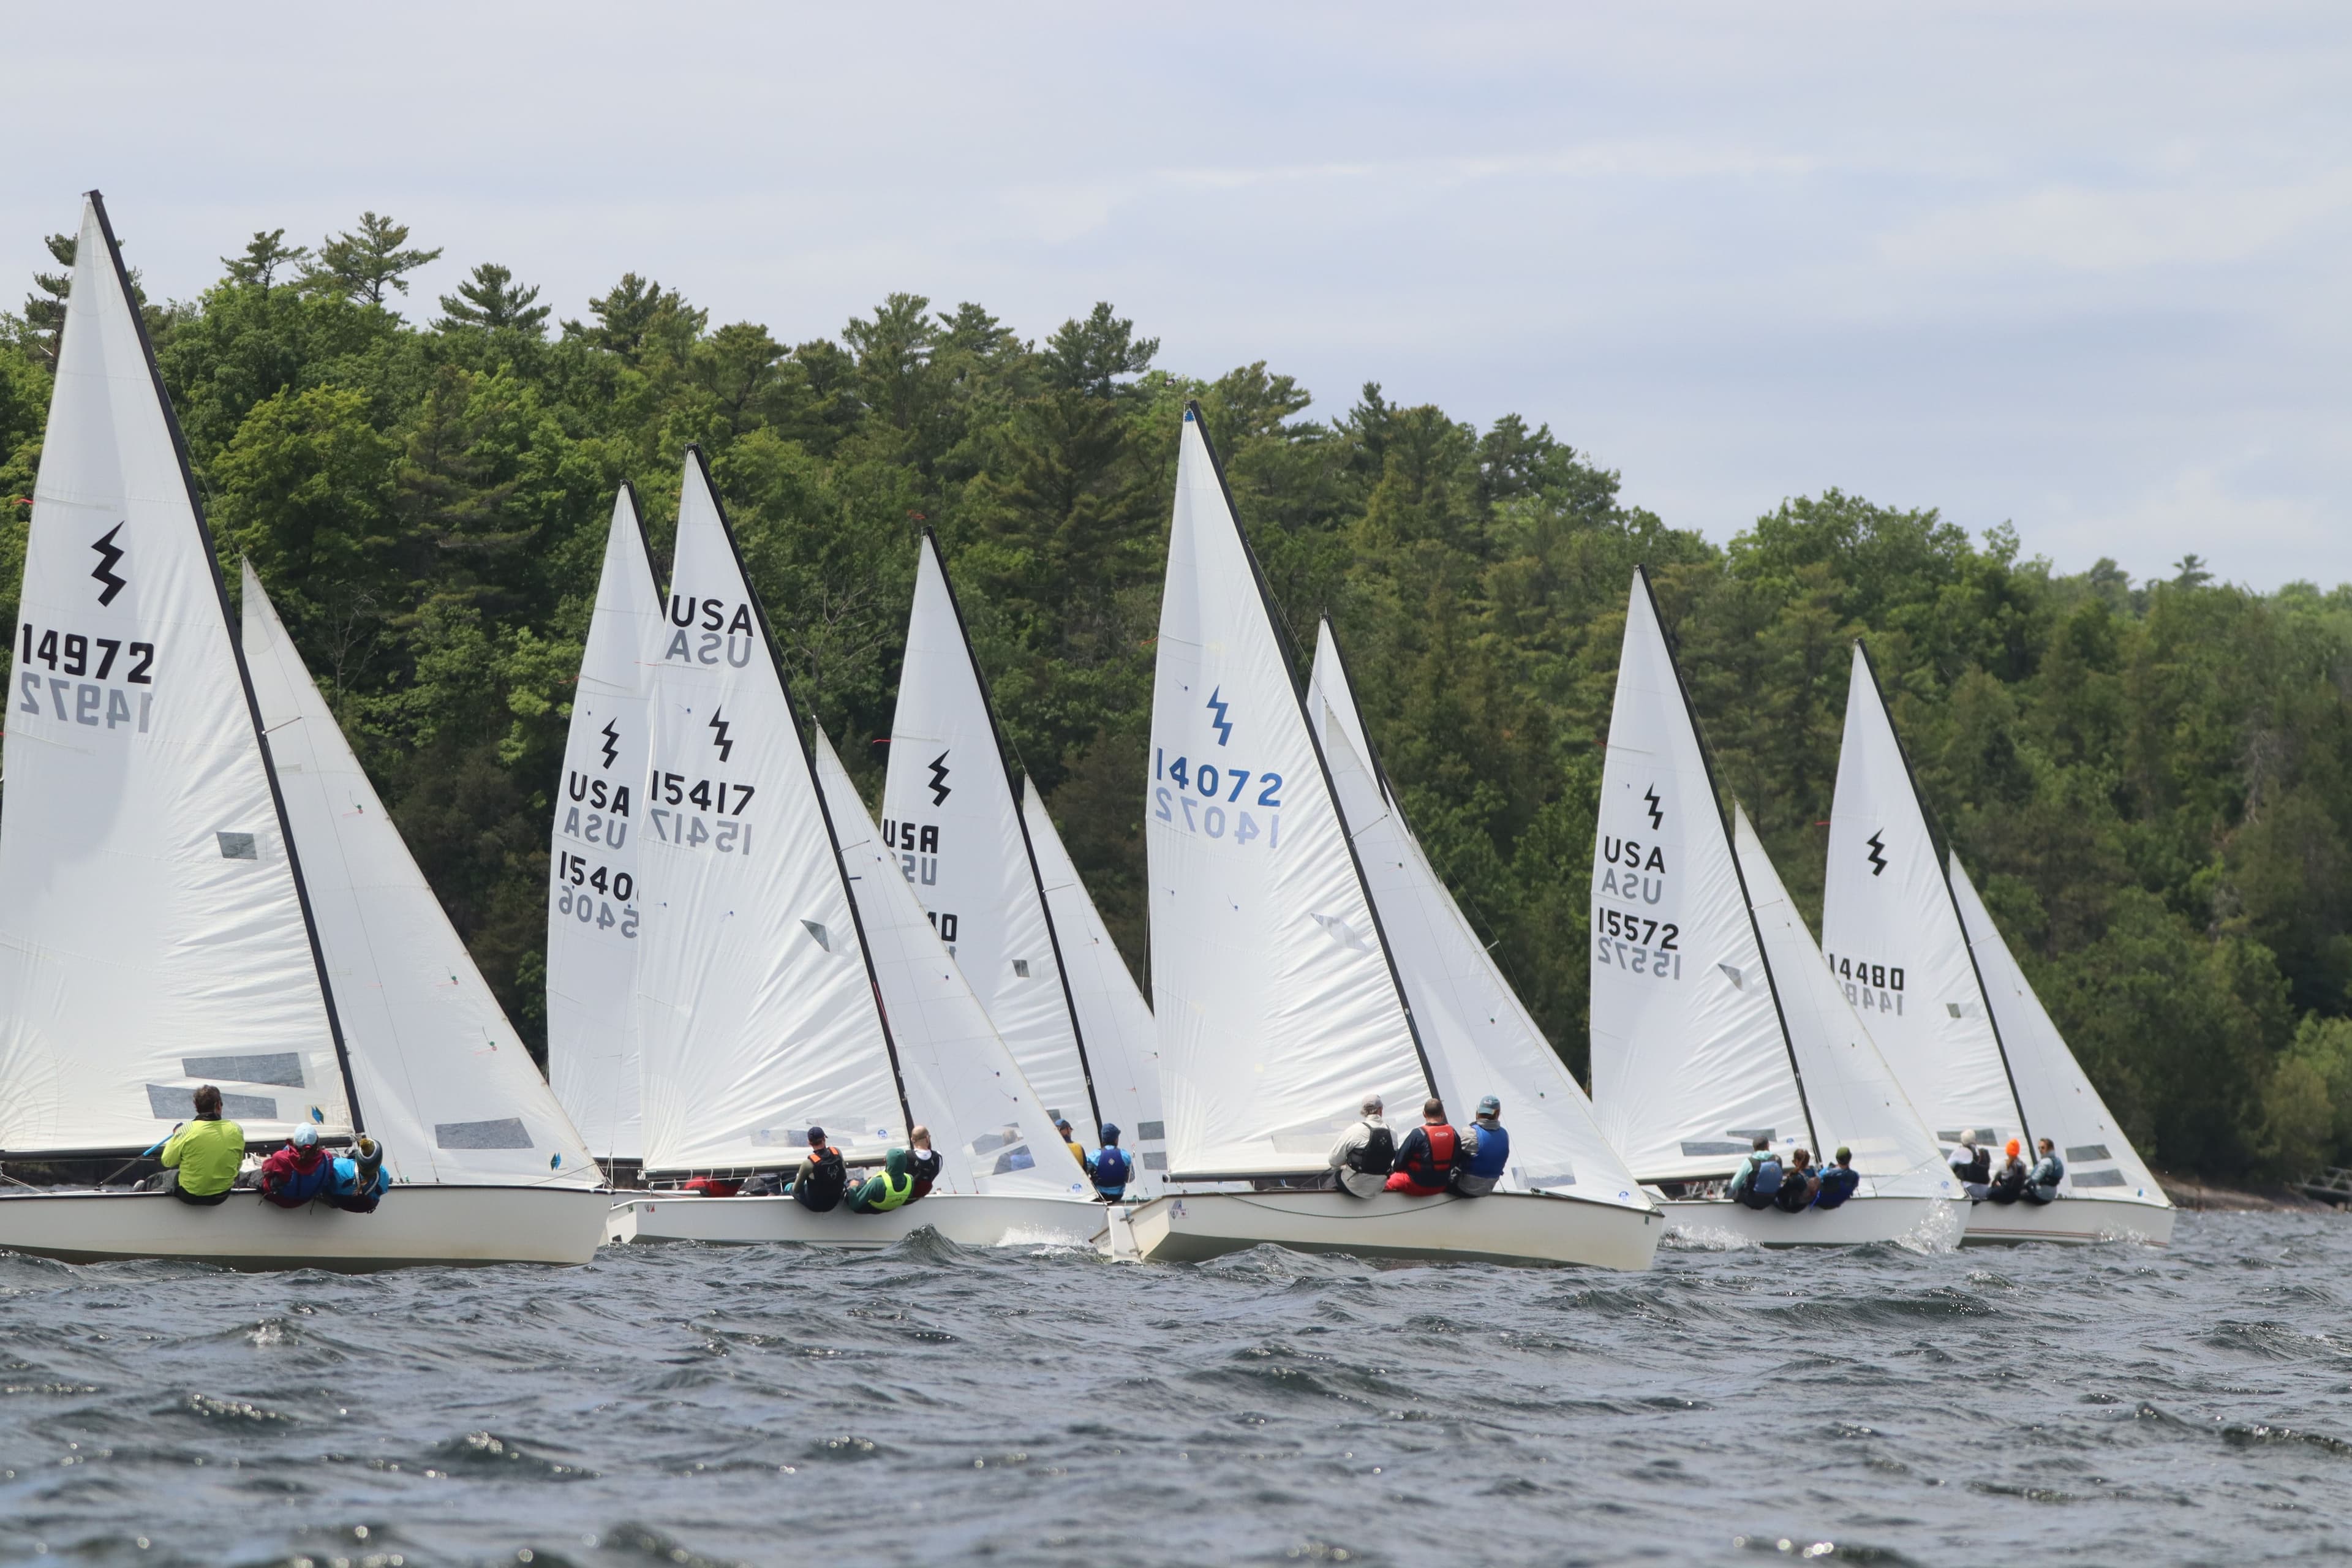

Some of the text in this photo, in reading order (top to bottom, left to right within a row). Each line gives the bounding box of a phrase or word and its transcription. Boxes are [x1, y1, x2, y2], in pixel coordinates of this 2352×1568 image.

[671, 594, 754, 638] USA
[23, 623, 154, 685] 14972
[569, 771, 630, 818] USA
[651, 770, 755, 816] 15417
[1156, 747, 1283, 807] 14072
[883, 818, 939, 854] USA
[1604, 835, 1666, 874] USA
[559, 850, 639, 902] 1540
[1599, 907, 1679, 951] 15572
[1829, 953, 1904, 991] 14480
